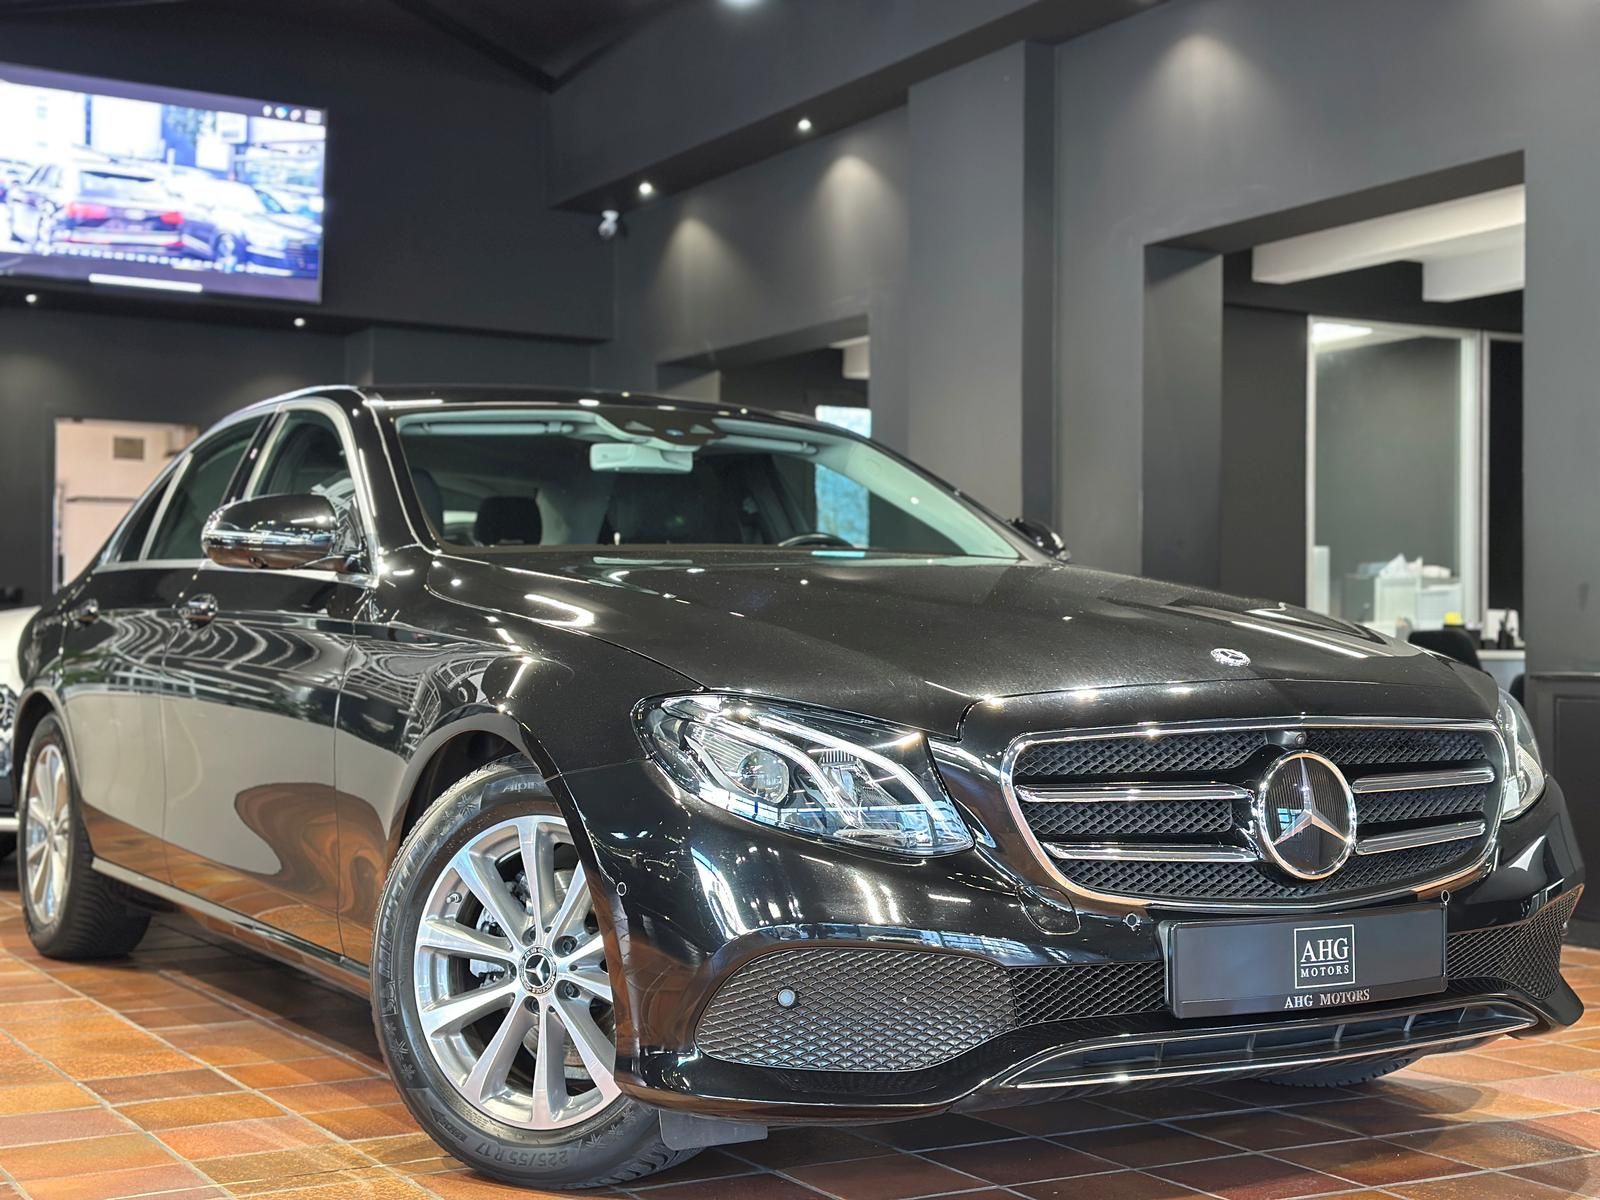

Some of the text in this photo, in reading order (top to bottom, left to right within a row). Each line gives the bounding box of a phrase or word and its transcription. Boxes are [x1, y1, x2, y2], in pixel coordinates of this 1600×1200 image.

[1300, 937, 1350, 963] AHG
[1300, 964, 1350, 978] MOTORS
[1284, 988, 1370, 1009] AHG MOTORS
[475, 1142, 491, 1157] 17
[510, 1149, 569, 1168] 225/55
